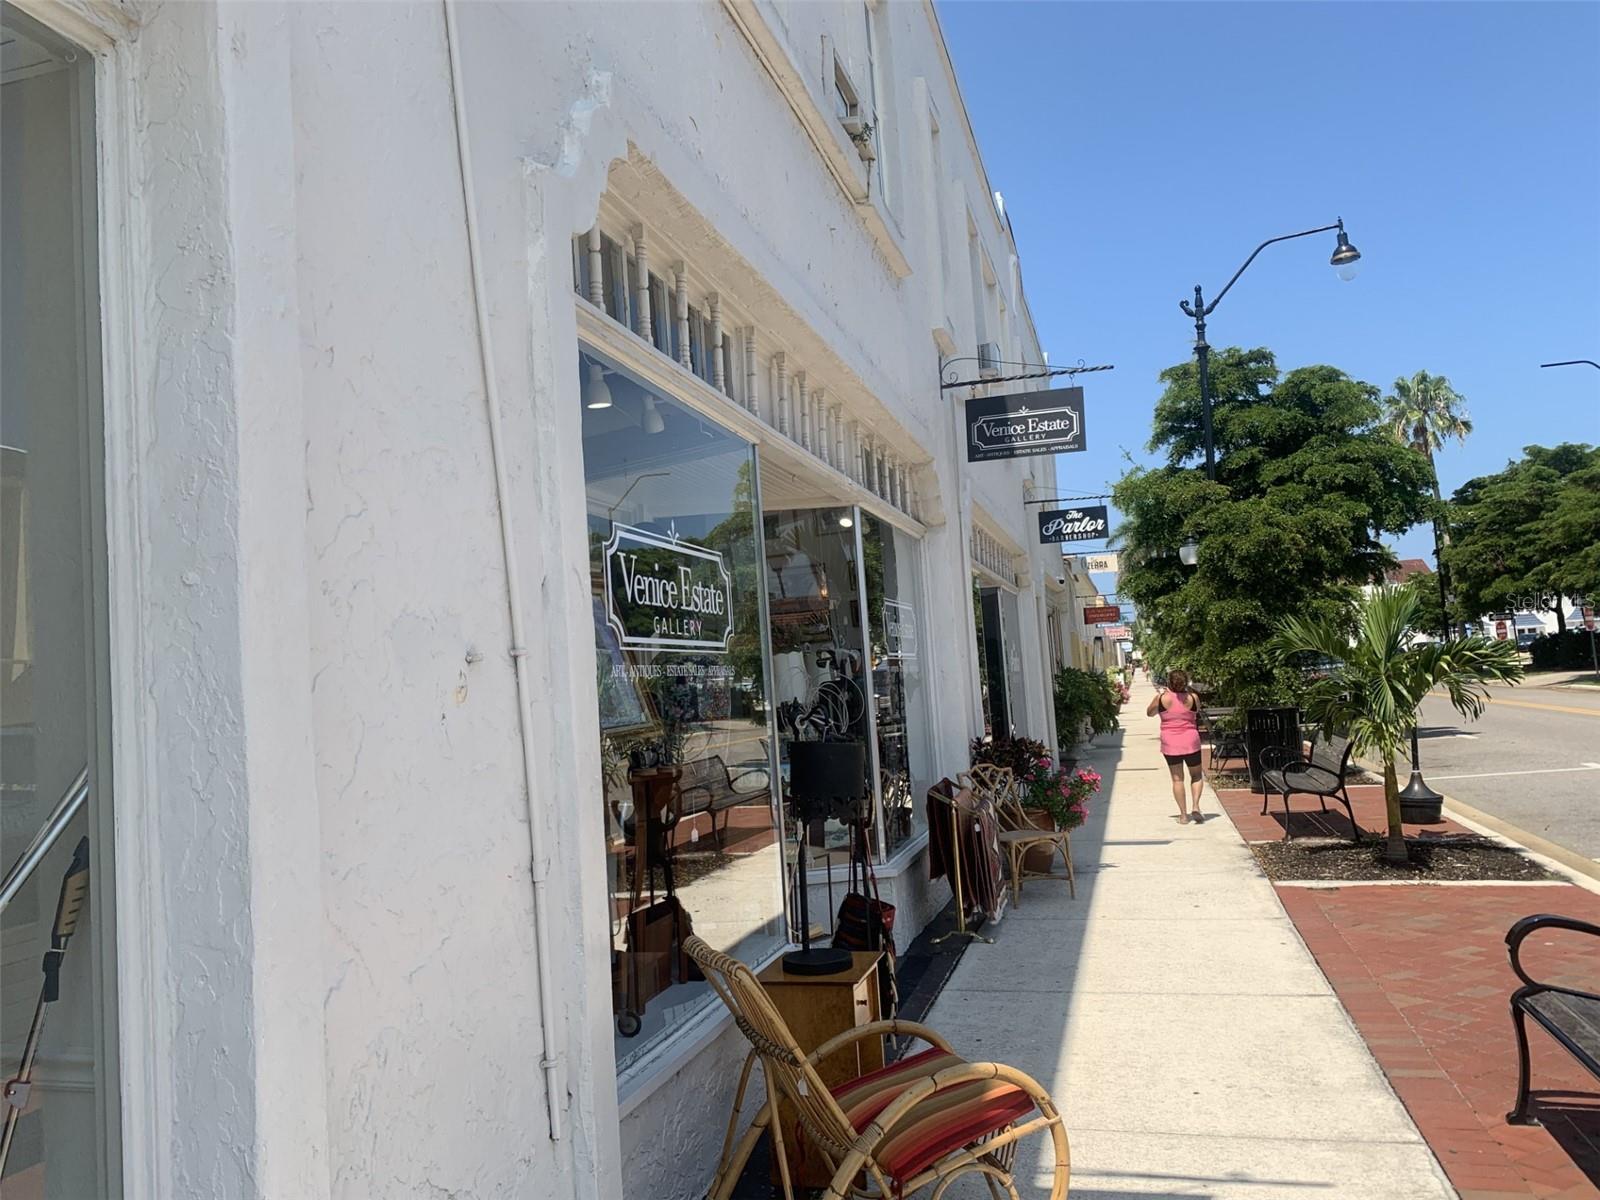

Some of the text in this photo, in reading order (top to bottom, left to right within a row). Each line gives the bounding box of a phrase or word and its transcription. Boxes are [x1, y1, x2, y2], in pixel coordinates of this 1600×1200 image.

[982, 417, 1070, 437] Venice Estate
[1004, 433, 1047, 443] GALLERY
[1066, 510, 1083, 520] The
[1042, 516, 1105, 536] Parlor
[617, 552, 724, 616] Venice Estate
[653, 616, 702, 636] GALLERY
[666, 665, 687, 677] ESTATE
